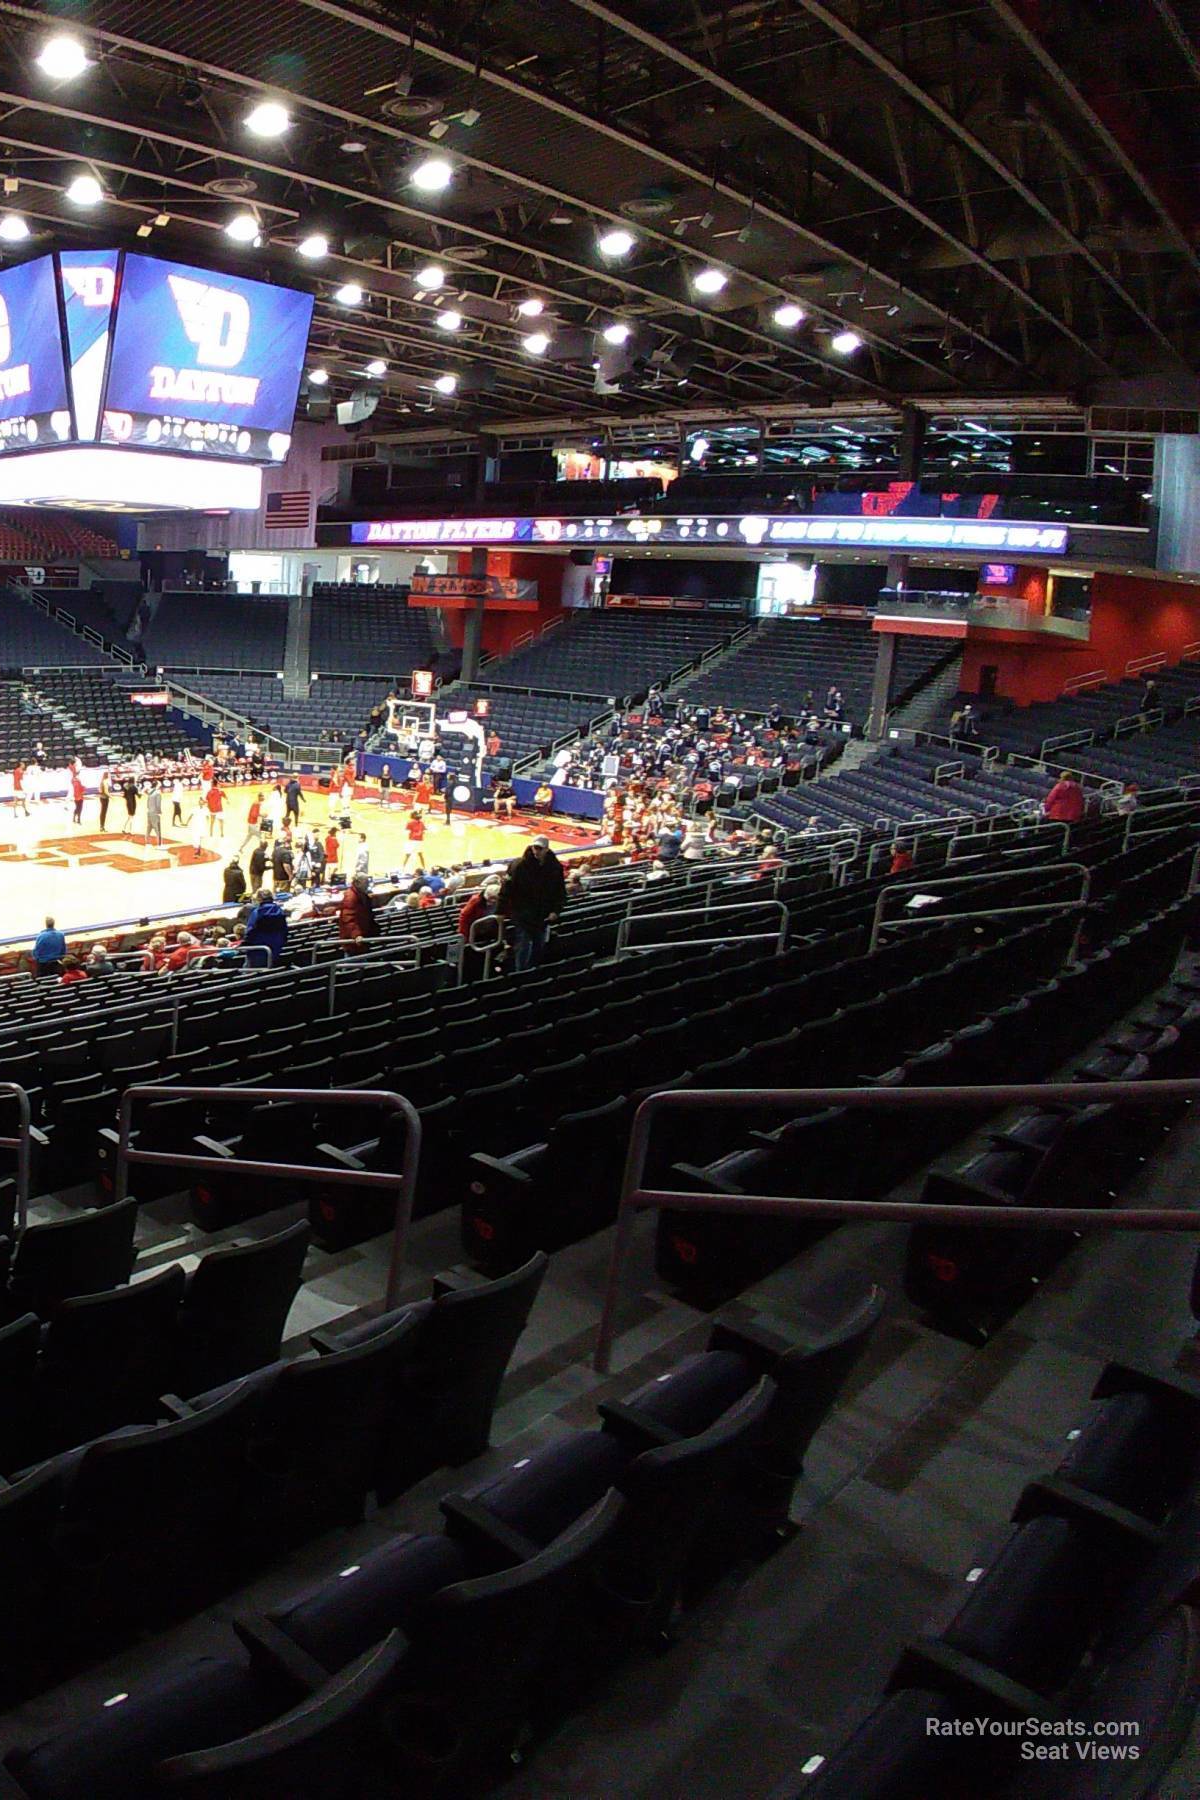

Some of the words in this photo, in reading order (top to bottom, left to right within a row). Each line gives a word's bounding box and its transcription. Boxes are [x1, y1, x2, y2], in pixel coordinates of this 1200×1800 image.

[149, 366, 260, 405] DAYTON
[367, 521, 442, 540] DAYTON
[440, 520, 516, 539] FLYERS
